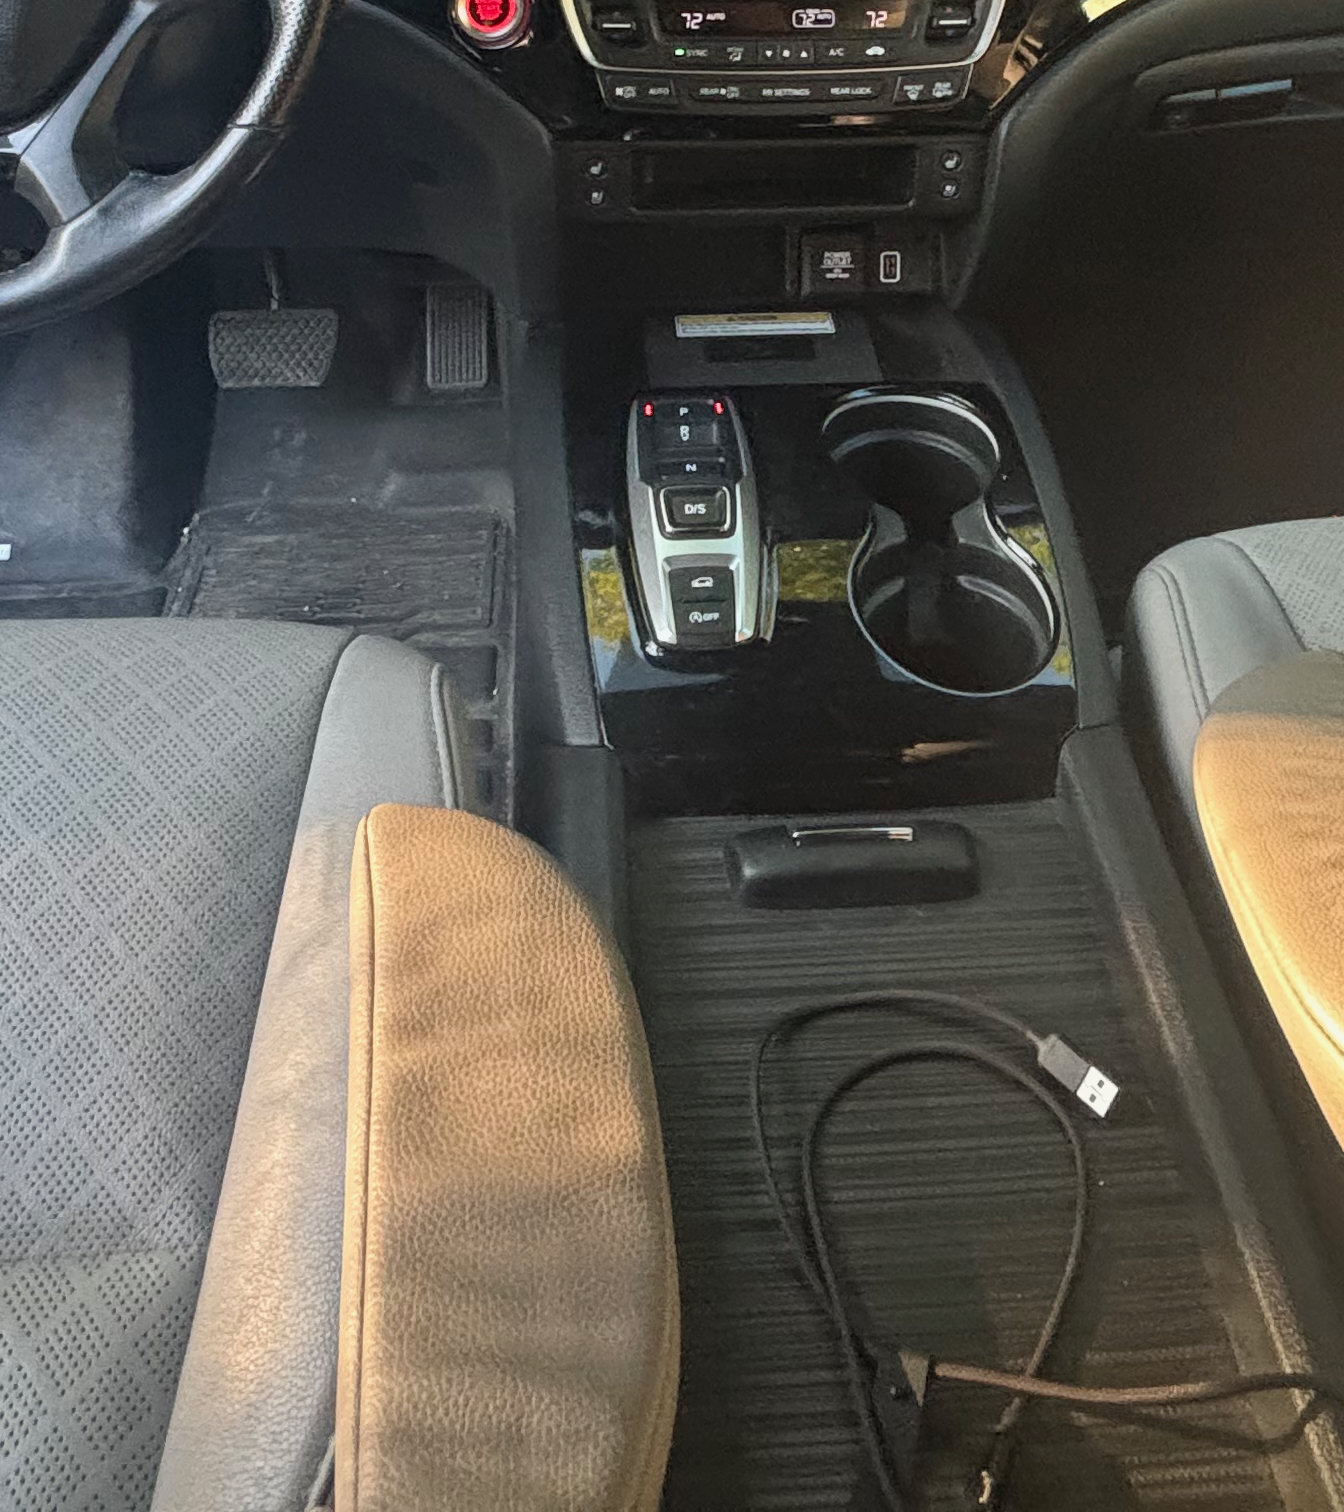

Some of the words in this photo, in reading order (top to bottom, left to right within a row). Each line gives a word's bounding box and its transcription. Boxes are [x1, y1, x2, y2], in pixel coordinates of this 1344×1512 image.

[680, 12, 704, 30] 72
[865, 10, 888, 29] 72
[828, 47, 845, 57] A/C
[679, 407, 690, 417] P
[683, 503, 707, 515] D/S
